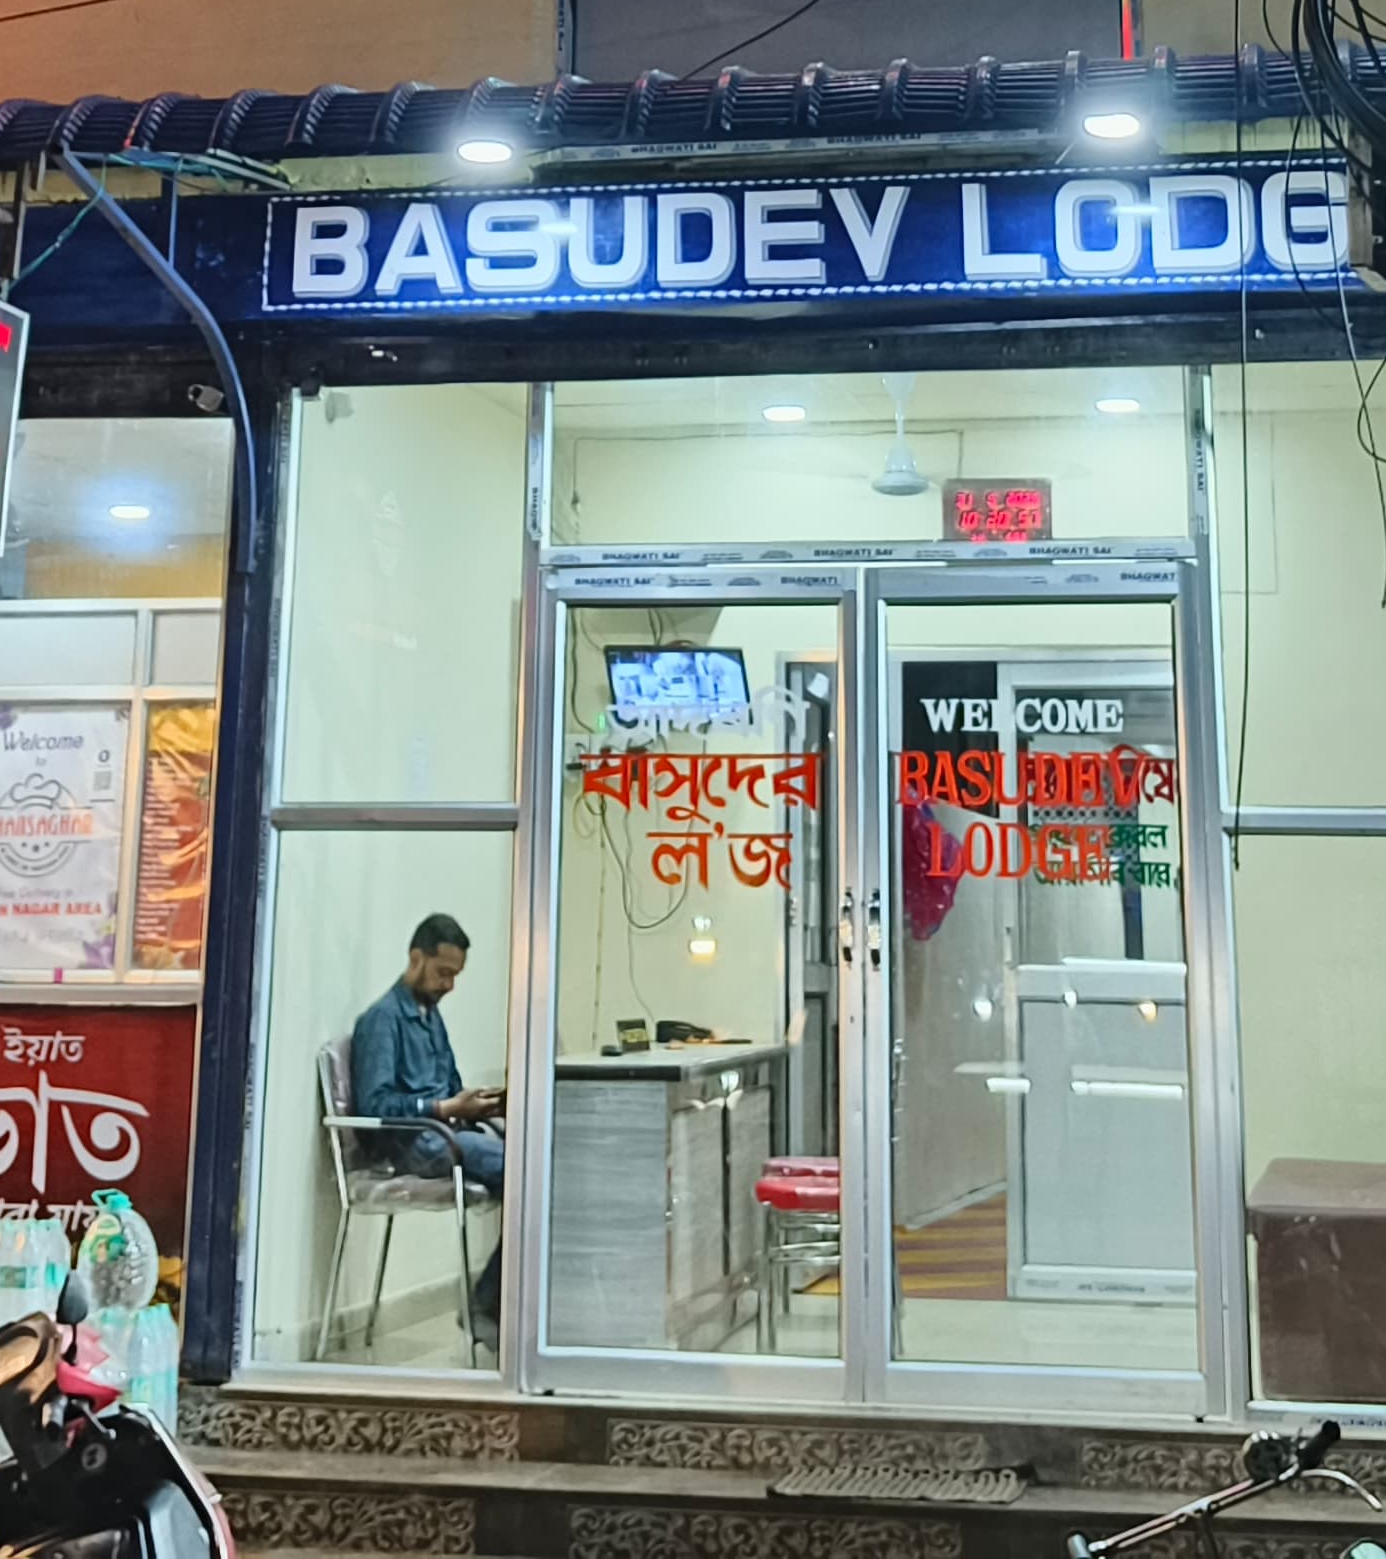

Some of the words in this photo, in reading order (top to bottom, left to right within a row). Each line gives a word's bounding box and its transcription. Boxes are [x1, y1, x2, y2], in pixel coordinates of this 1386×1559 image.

[293, 185, 905, 298] BASUDEV
[961, 171, 1348, 280] LODG
[920, 698, 1124, 733] WELCOME
[3, 731, 84, 751] Welcome
[895, 750, 1149, 808] BASUDEV
[926, 822, 1110, 880] LODGE
[12, 903, 60, 916] NAGAR
[65, 902, 102, 915] AREA
